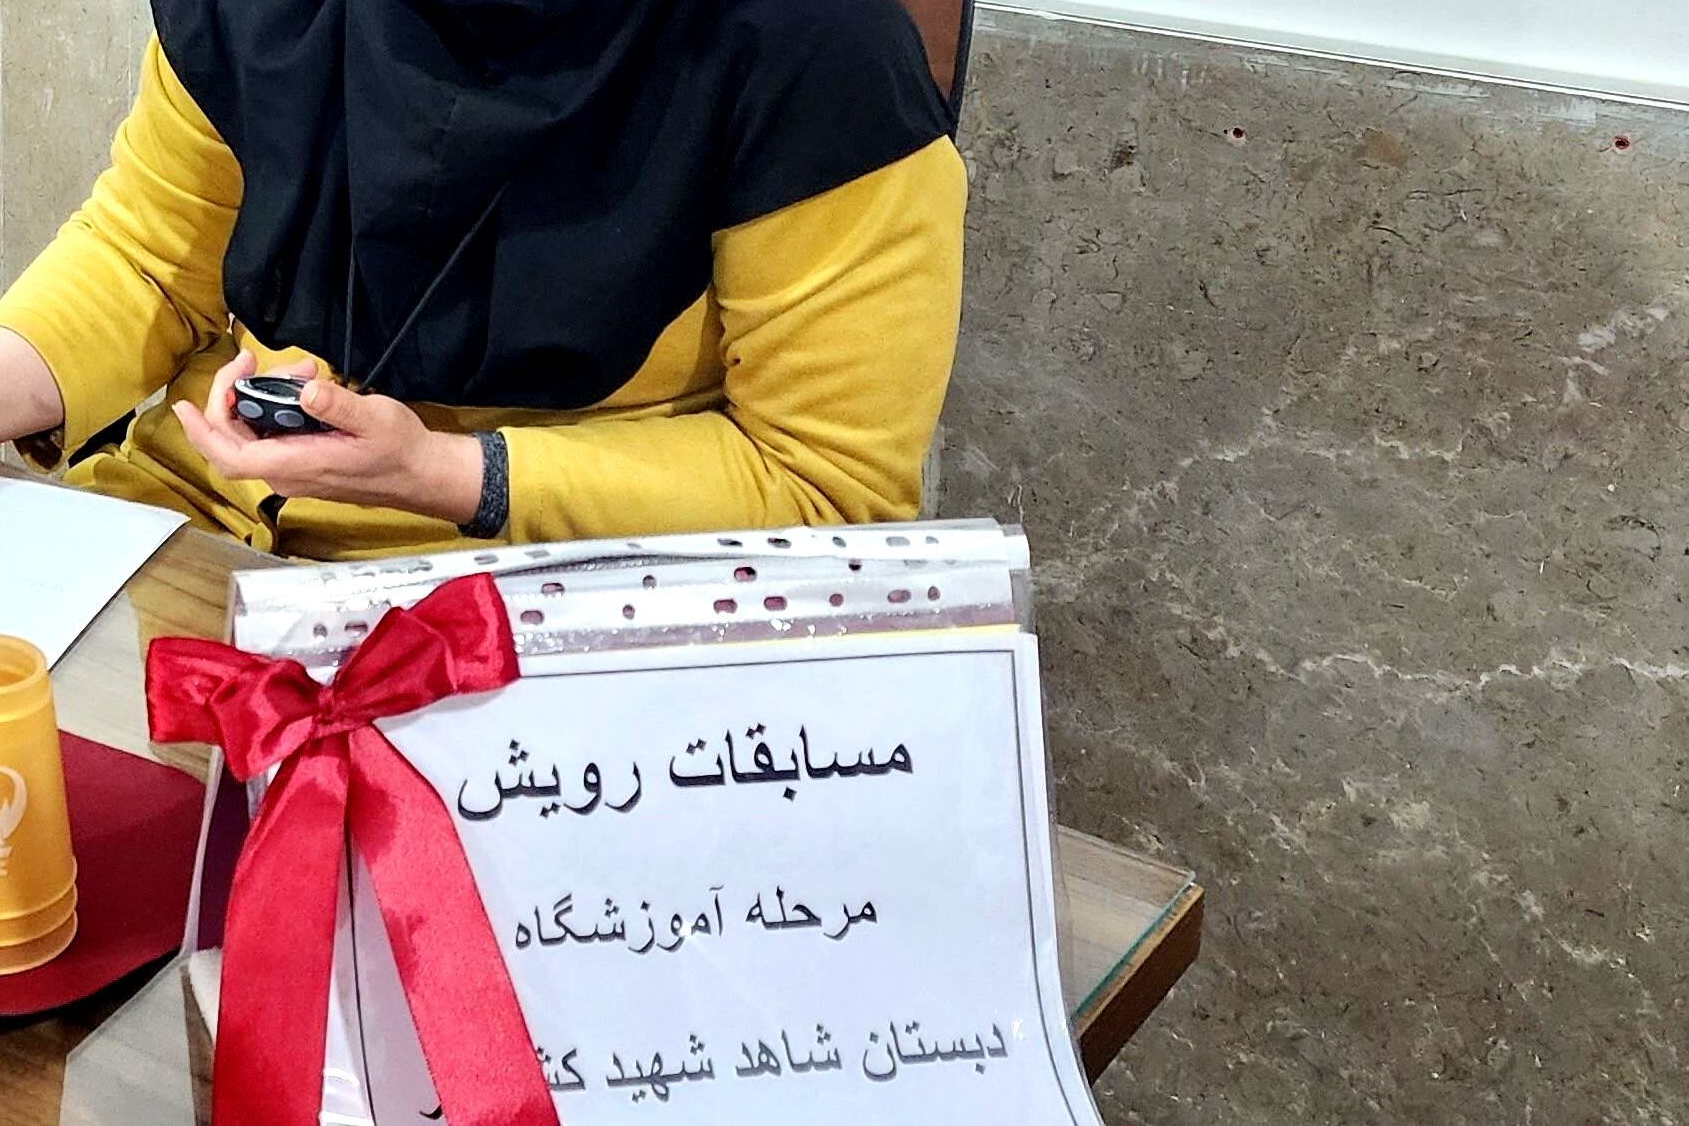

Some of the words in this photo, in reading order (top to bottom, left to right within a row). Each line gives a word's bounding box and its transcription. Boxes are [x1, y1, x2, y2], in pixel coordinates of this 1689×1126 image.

[456, 738, 643, 821] رویش
[669, 722, 915, 802] مسابقات
[514, 883, 725, 955] آموزشگاه
[745, 884, 879, 942] مرحله
[605, 1033, 716, 1103] شهید
[734, 1021, 843, 1078] شاهد
[862, 1019, 1009, 1083] دبستان
